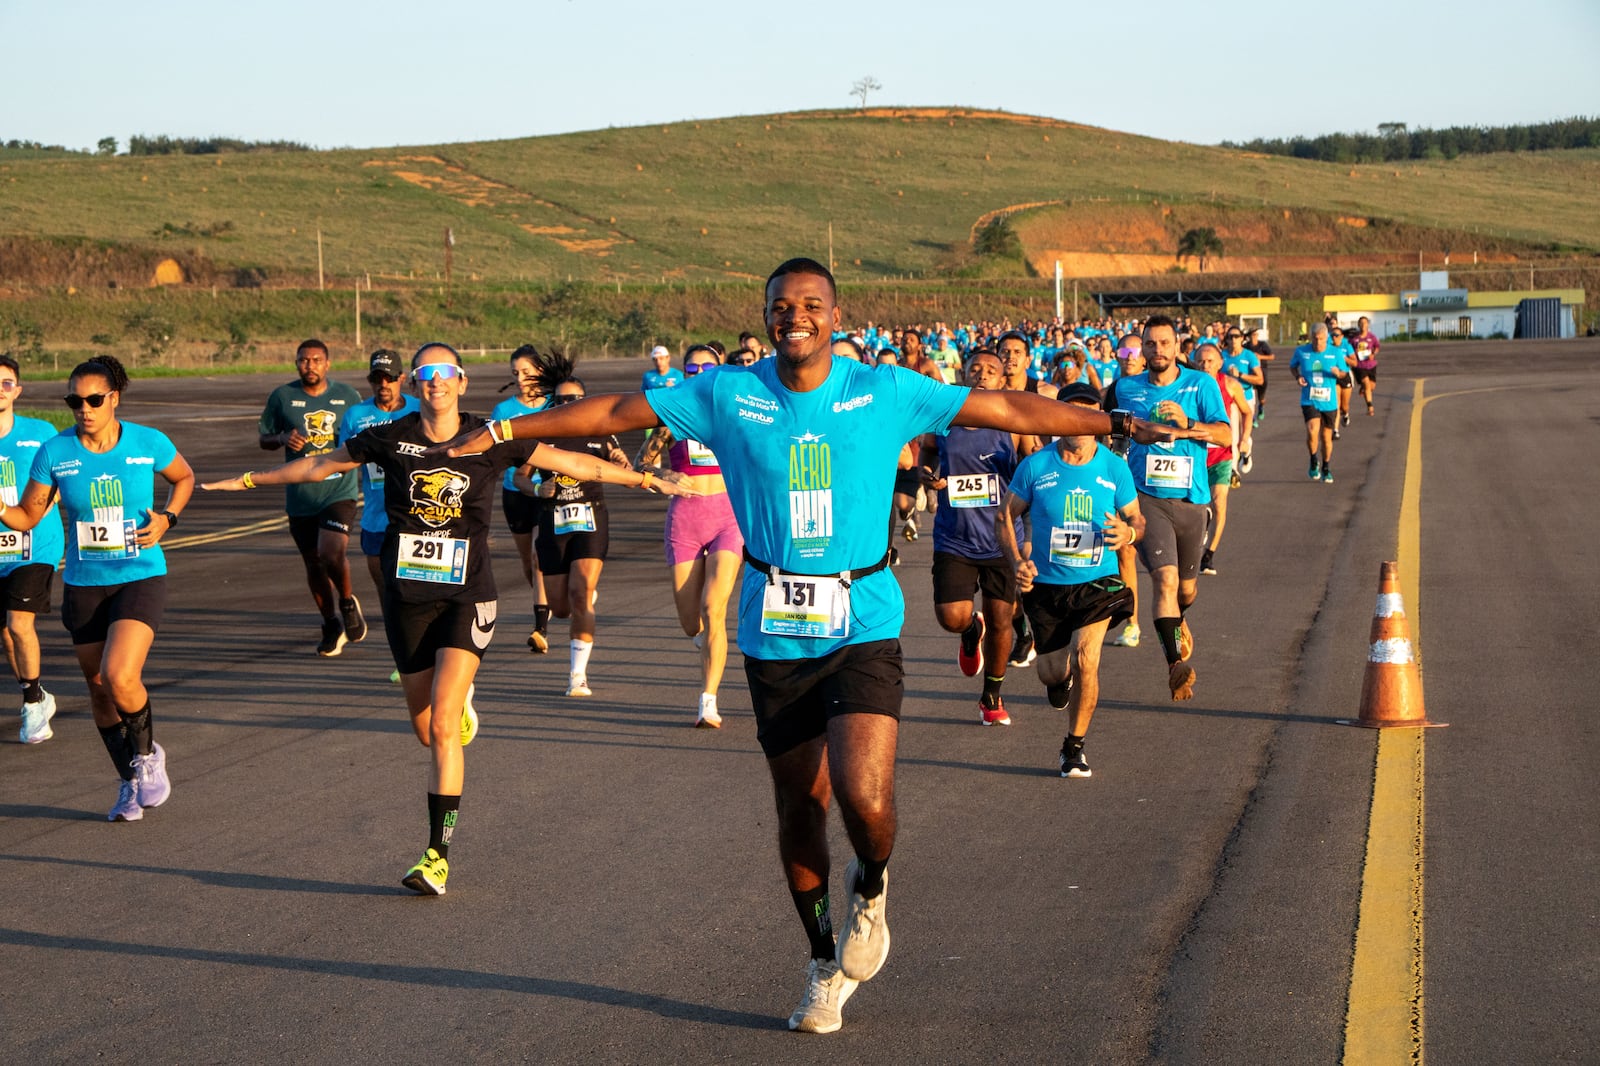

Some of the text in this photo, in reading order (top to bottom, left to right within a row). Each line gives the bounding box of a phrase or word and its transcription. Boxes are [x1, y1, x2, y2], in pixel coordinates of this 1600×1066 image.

[739, 408, 774, 423] punntuo
[789, 442, 831, 491] AERO
[90, 479, 124, 509] AERO
[956, 478, 983, 492] 245
[408, 506, 462, 518] JAGUAR
[562, 507, 579, 519] 117
[789, 488, 833, 539] RUN
[1064, 494, 1093, 522] AERO
[90, 526, 109, 542] 12
[1064, 533, 1082, 549] 17
[412, 539, 444, 561] 291
[782, 581, 816, 607] 131
